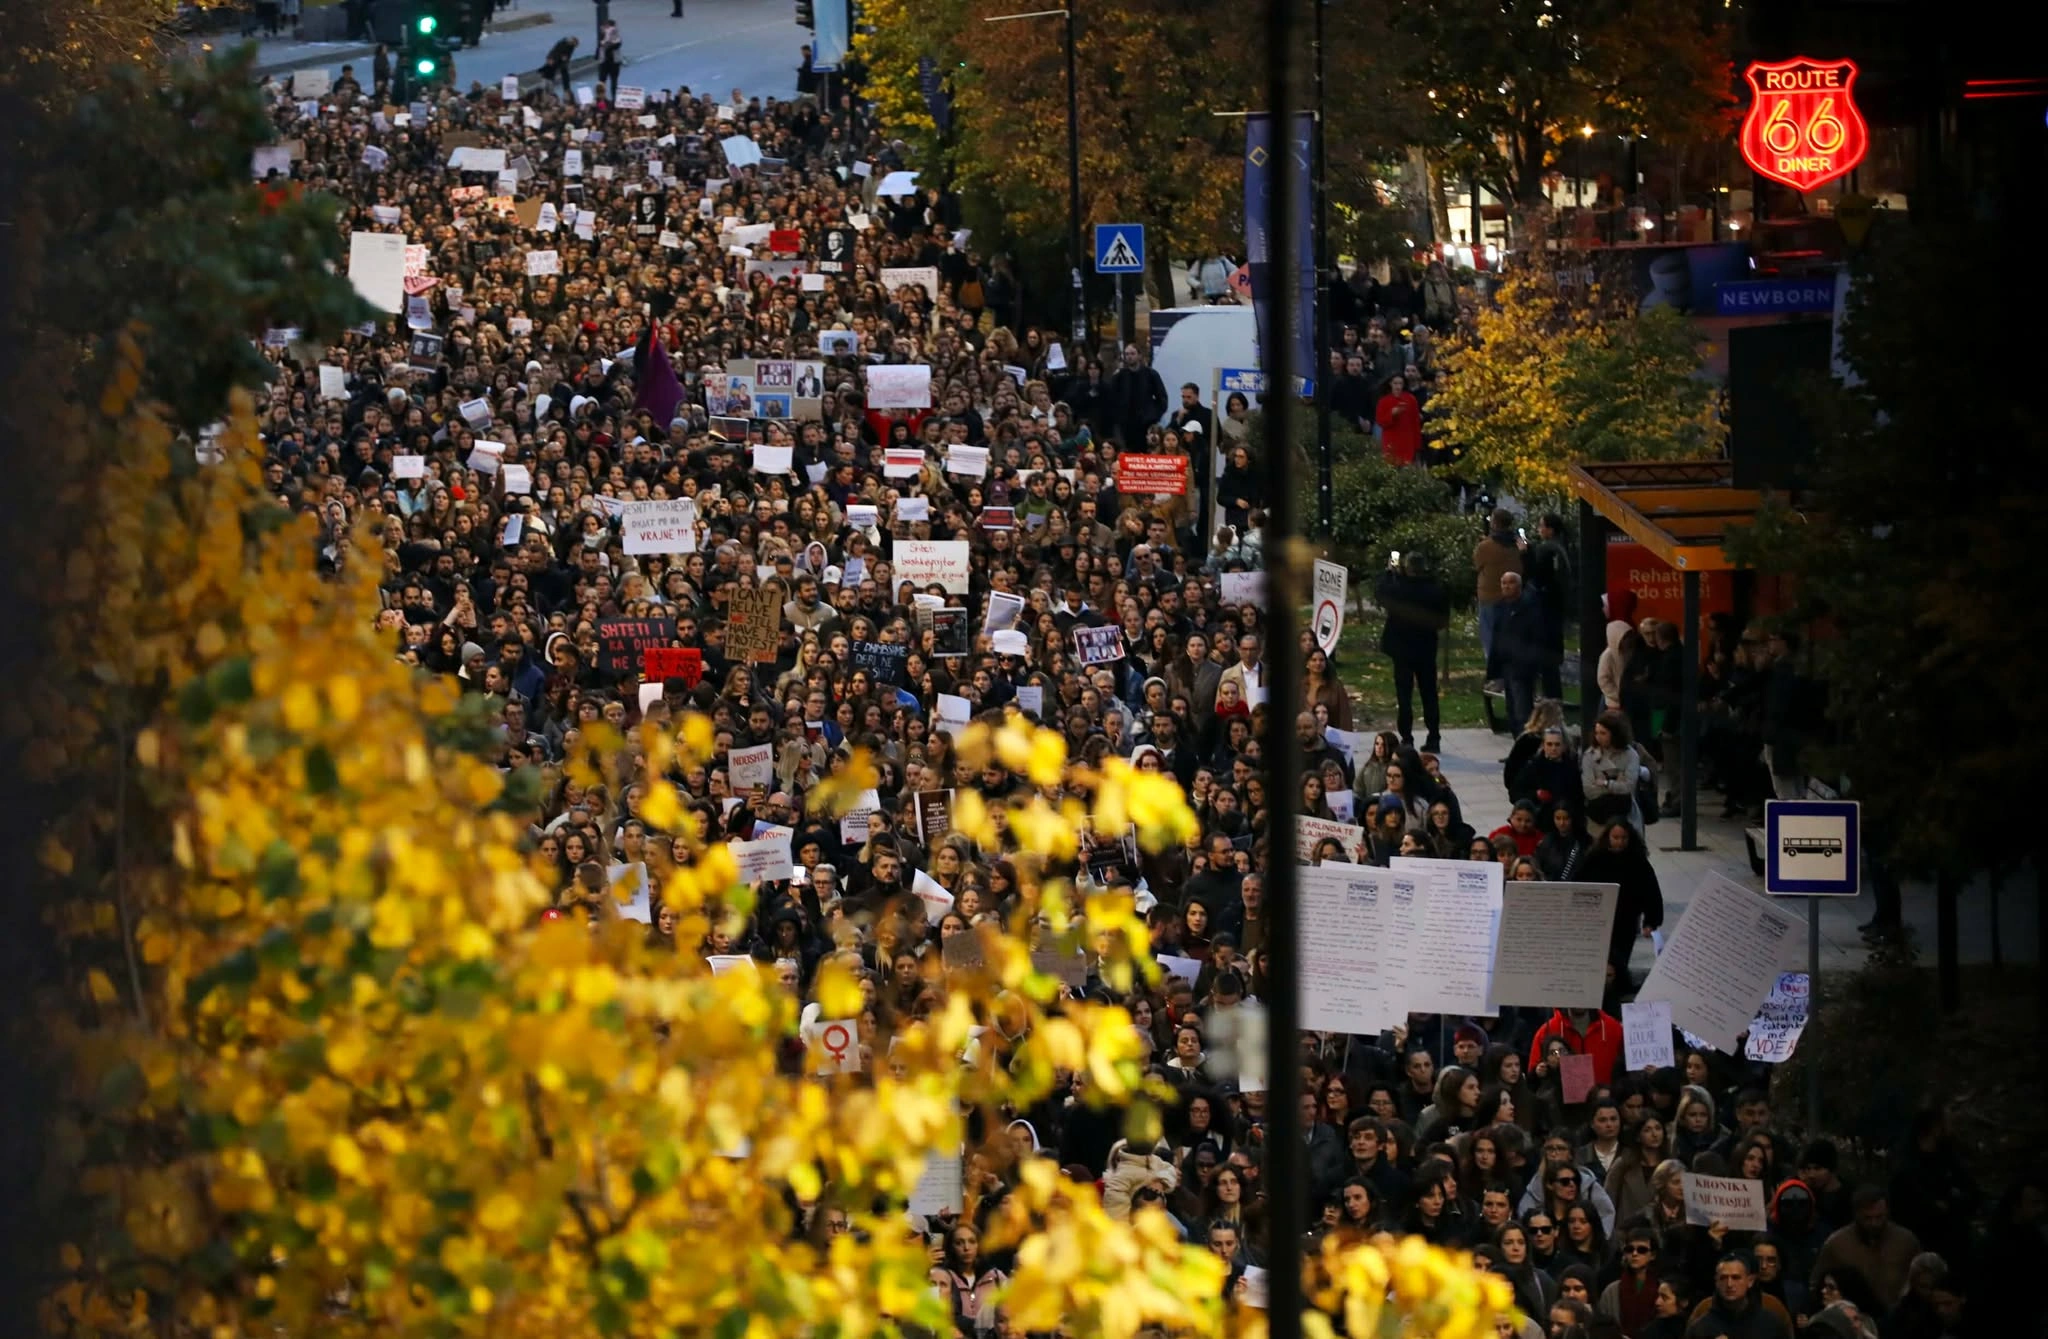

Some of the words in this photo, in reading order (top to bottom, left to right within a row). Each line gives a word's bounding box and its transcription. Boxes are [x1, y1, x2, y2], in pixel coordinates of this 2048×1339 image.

[1766, 69, 1840, 90] ROUTE
[1763, 97, 1845, 156] 66
[1778, 156, 1832, 174] DINER
[1723, 288, 1831, 306] NEWBORN
[600, 622, 650, 639] SHTETI
[728, 633, 777, 652] PROTEST
[852, 641, 860, 652] E
[732, 751, 769, 767] NDOSHTA
[1305, 821, 1342, 834] ARLINDA
[1695, 1178, 1748, 1193] KRONIKA
